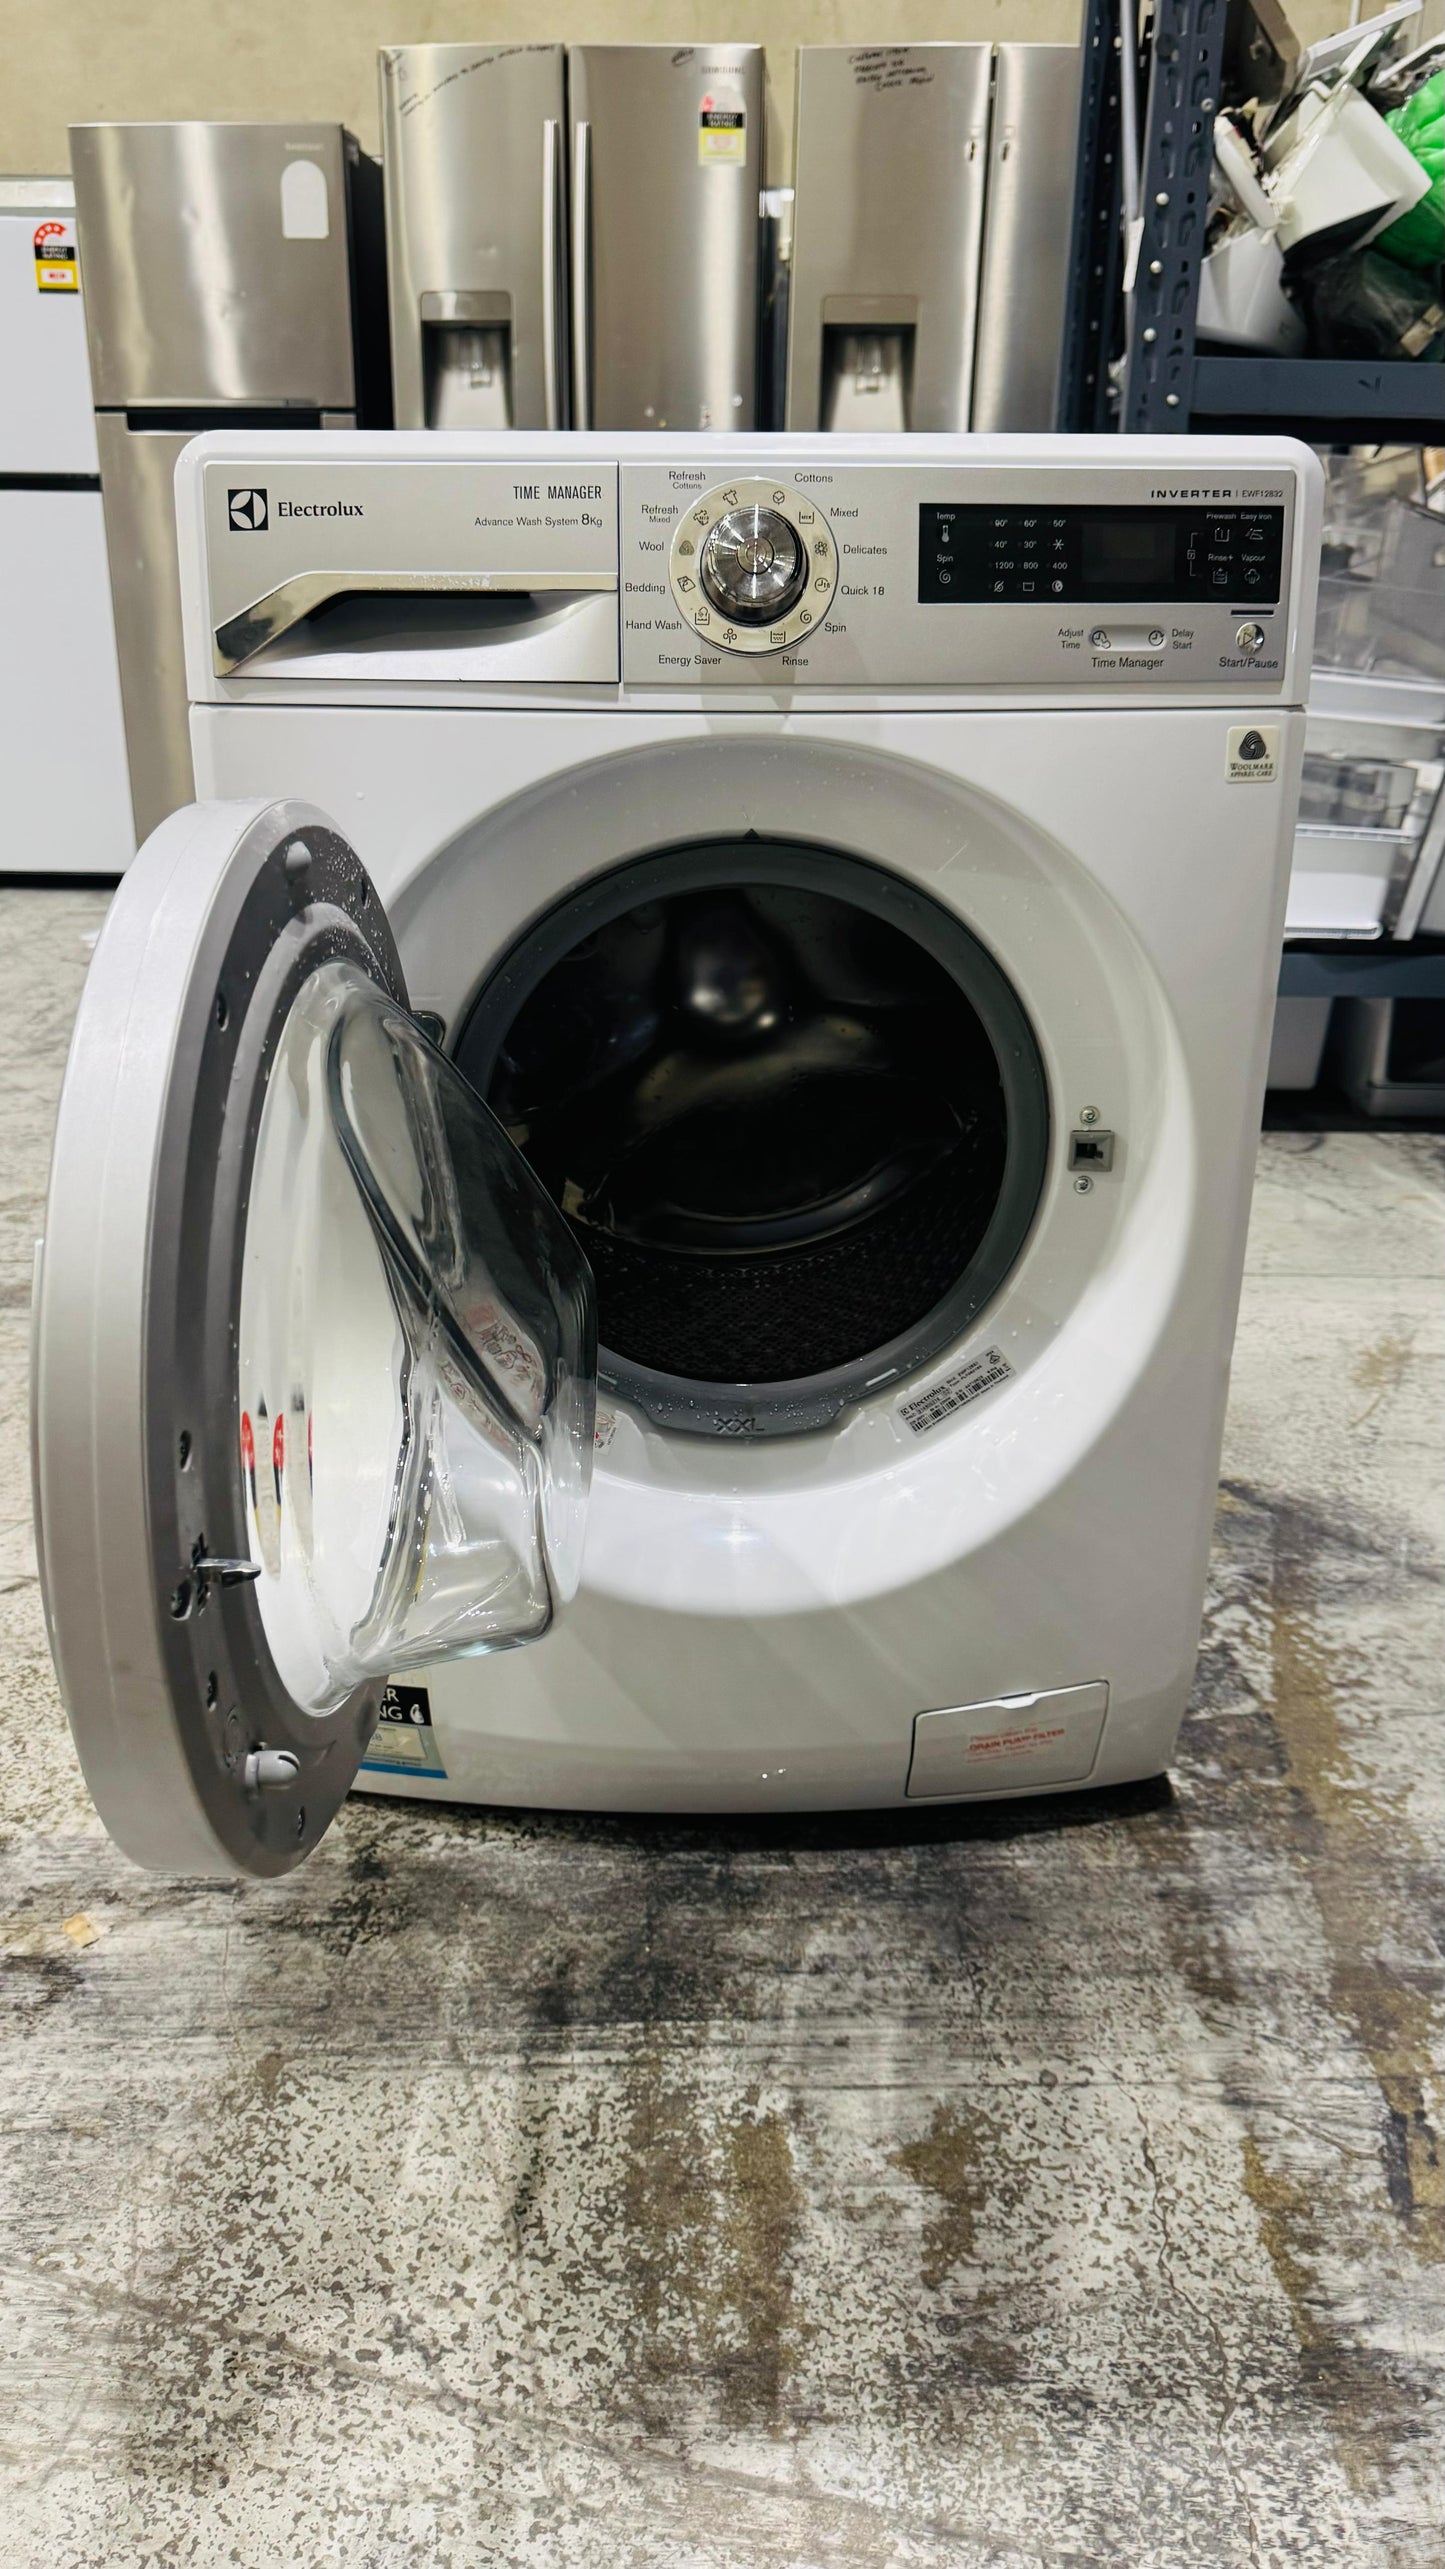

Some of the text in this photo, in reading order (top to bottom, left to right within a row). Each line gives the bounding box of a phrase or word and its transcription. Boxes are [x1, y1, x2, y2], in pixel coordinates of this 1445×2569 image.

[669, 471, 706, 481] Refresh
[794, 473, 833, 483] Cottons
[672, 482, 702, 490] Cottons
[513, 485, 601, 500] TIME MANAGER
[1151, 490, 1231, 498] INVERTER
[278, 502, 364, 517] Electrolux
[641, 505, 678, 515] Refresh
[830, 507, 858, 517] Mixed
[475, 514, 602, 528] Advance Wash System 8Kg
[937, 512, 955, 520] Temp
[1240, 513, 1257, 521] Easy
[639, 541, 664, 551] Wool
[843, 545, 887, 554] Delicates
[937, 555, 953, 563] Spin
[1241, 554, 1265, 562] Vapour
[1052, 562, 1068, 570] 400
[626, 583, 666, 594] Bedding
[841, 585, 885, 596] Quick 18
[626, 620, 682, 630] Hand Wash
[824, 622, 847, 633] Spin
[1058, 629, 1083, 638] Adjust
[1172, 629, 1194, 639] Delay
[1061, 641, 1080, 649] Time
[1172, 641, 1192, 649] Start
[658, 655, 721, 666] Energy Saver
[782, 656, 808, 666] Rinse
[1092, 658, 1164, 670] Time Manager
[1219, 657, 1278, 668] Start/Pause
[909, 1385, 946, 1411] Electrolux
[716, 1418, 765, 1433] XXL
[969, 1741, 1001, 1751] DRAIN
[1033, 1728, 1065, 1740] FILTER
